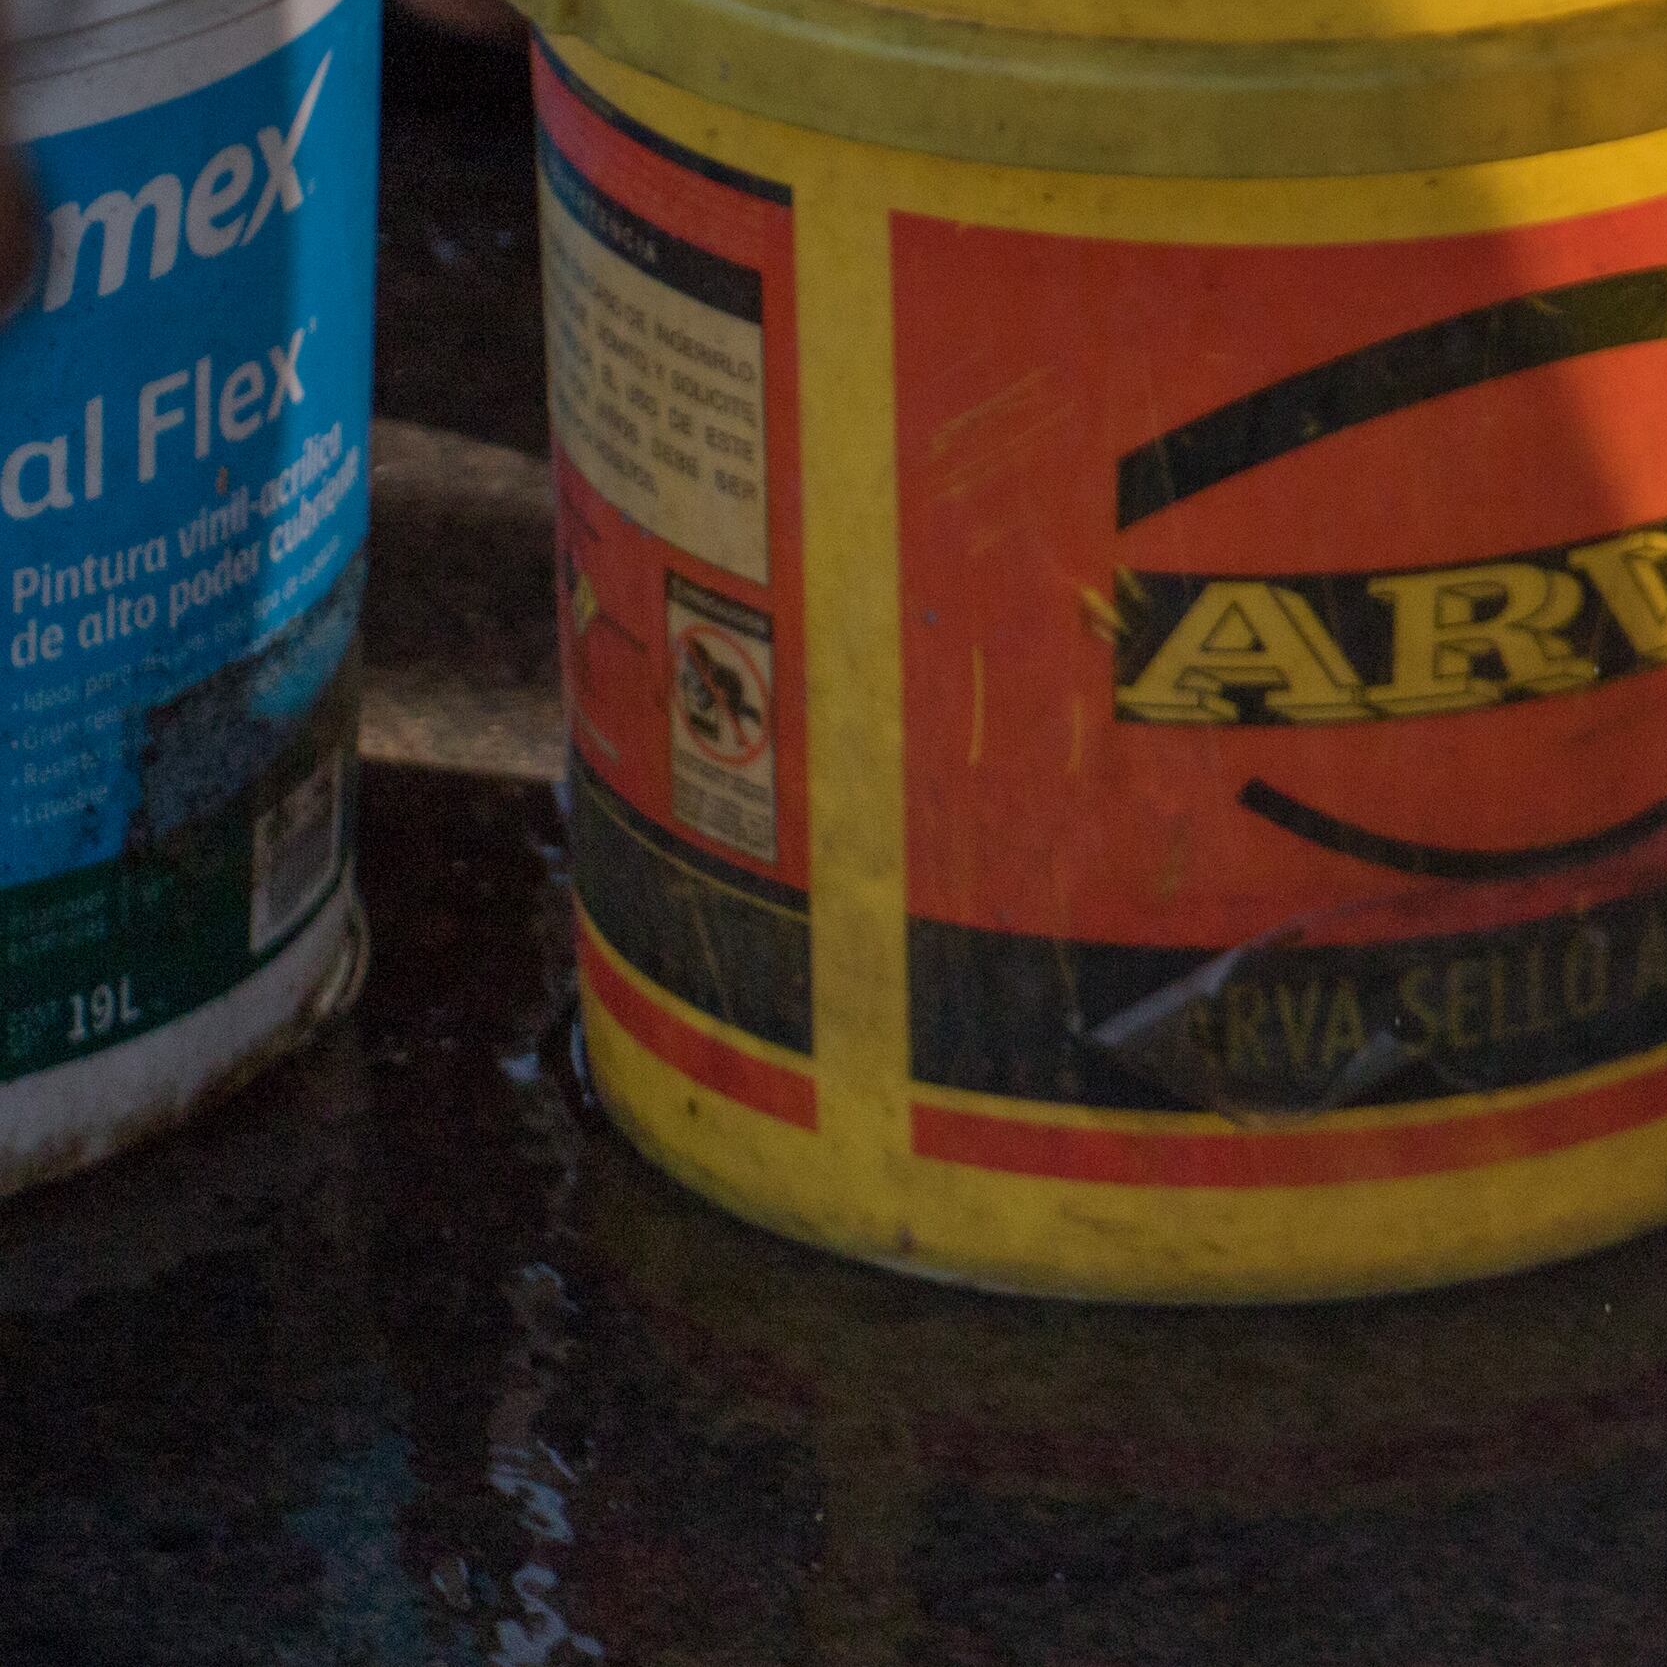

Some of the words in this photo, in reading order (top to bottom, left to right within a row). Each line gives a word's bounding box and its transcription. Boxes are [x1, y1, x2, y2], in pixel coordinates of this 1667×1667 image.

[42, 49, 333, 314] mex
[0, 392, 103, 520] al
[137, 326, 306, 484] Flex
[10, 620, 65, 669] de
[77, 592, 158, 652] alto
[168, 542, 262, 628] poder
[11, 532, 168, 616] Pintura
